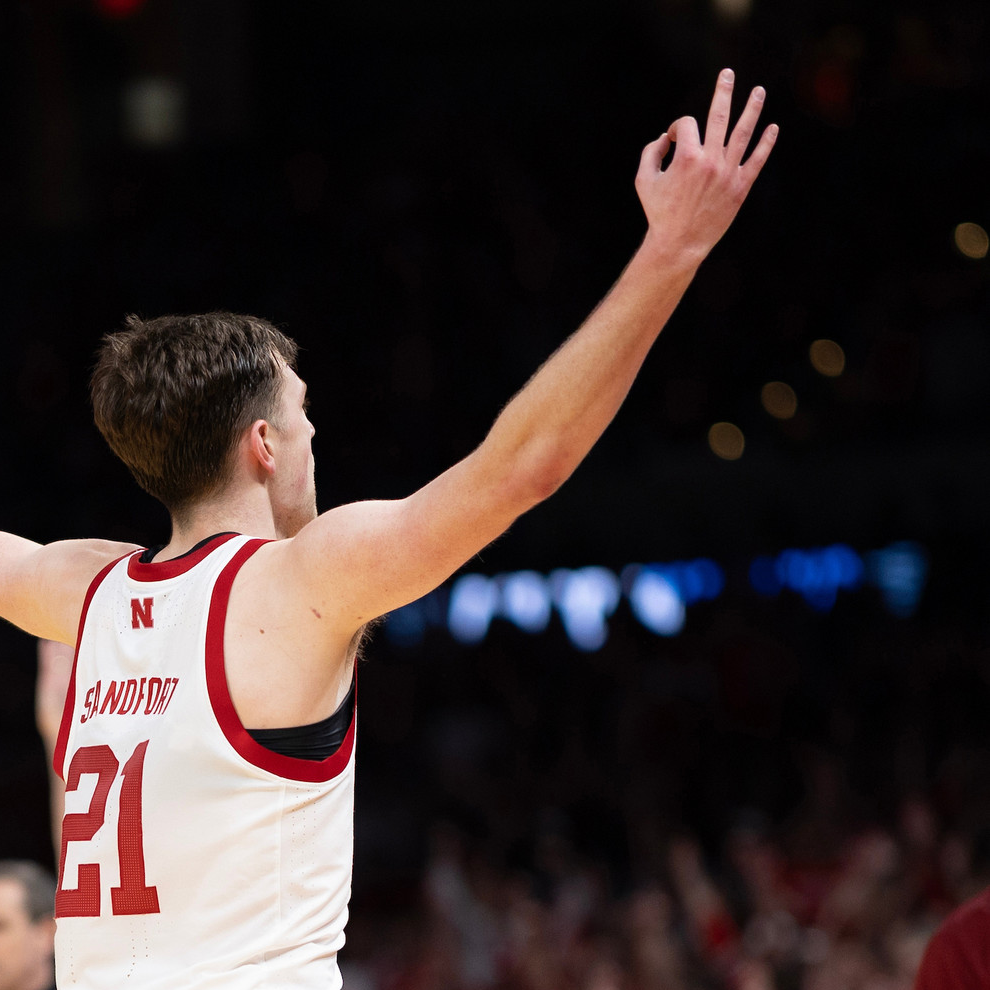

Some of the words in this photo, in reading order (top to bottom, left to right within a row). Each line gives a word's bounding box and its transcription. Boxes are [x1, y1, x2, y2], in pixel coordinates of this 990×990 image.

[131, 597, 154, 629] N
[80, 677, 179, 723] SANDFORT
[54, 739, 161, 918] 21
